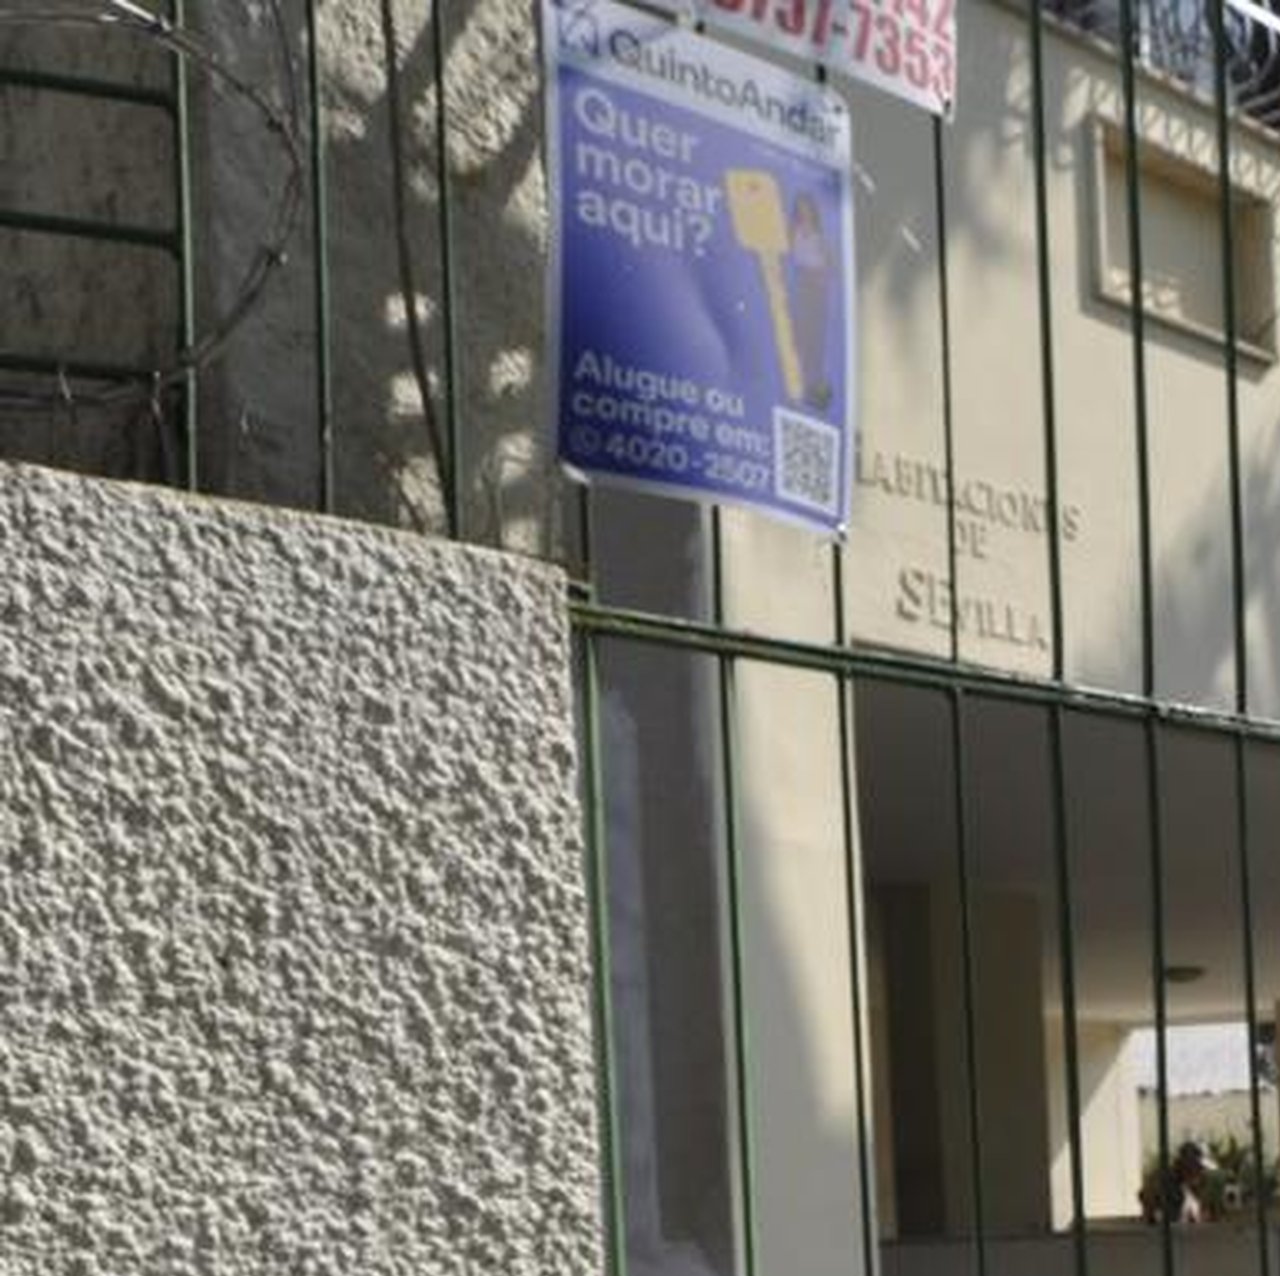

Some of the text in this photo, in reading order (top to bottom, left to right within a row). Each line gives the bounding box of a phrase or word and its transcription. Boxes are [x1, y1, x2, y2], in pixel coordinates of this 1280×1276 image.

[609, 30, 839, 148] QuintoAndar
[574, 89, 700, 162] Quer
[576, 142, 722, 215] morar
[576, 191, 712, 258] aqui?
[574, 351, 745, 418] Alugue ou
[572, 391, 770, 458] compre em:
